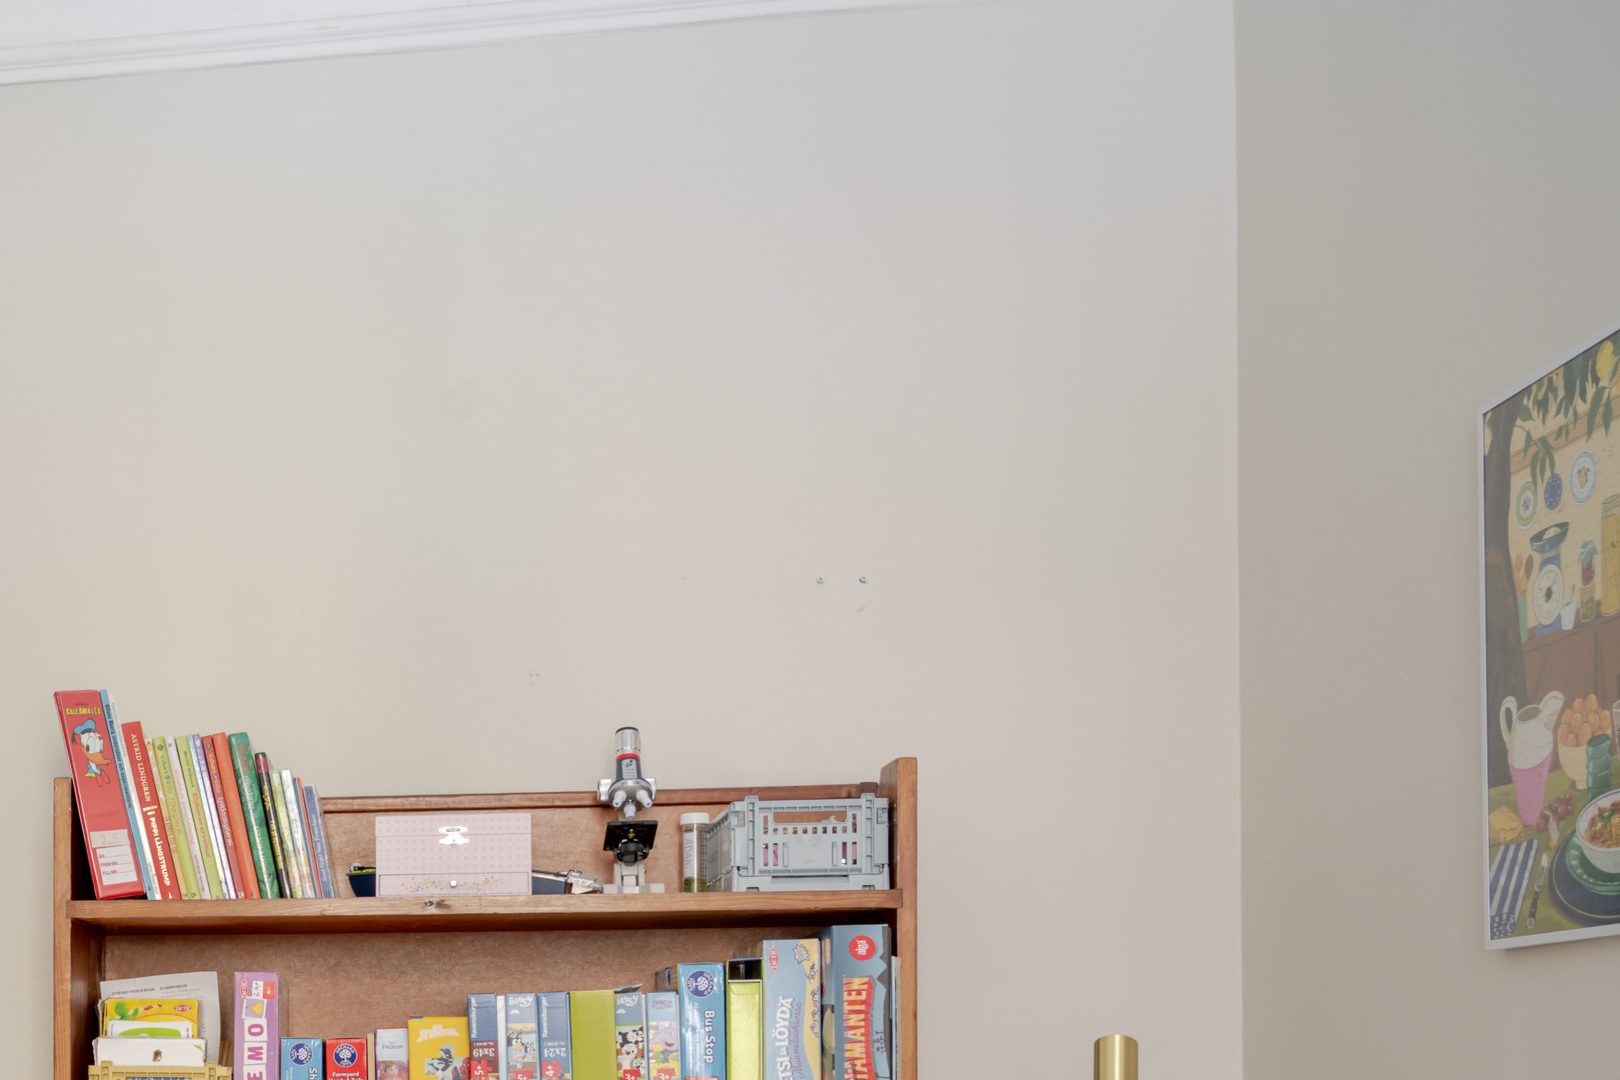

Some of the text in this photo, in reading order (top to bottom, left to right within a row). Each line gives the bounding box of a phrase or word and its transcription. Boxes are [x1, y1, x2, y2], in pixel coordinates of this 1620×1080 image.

[131, 734, 170, 886] ASTRID LINDGREN PIPPI LÅNGSTRUMP
[856, 939, 869, 956] alga
[703, 972, 715, 995] ORCHARD
[772, 996, 793, 1046] LÖYDÄ
[704, 1010, 715, 1063] Bus Stop
[791, 1001, 804, 1079] Muumilaaksossa
[336, 1044, 355, 1054] ORCHARD
[473, 1048, 494, 1057] 3x49
[544, 1048, 566, 1057] 2x24
[475, 1065, 484, 1075] 5+
[546, 1065, 555, 1076] 4+
